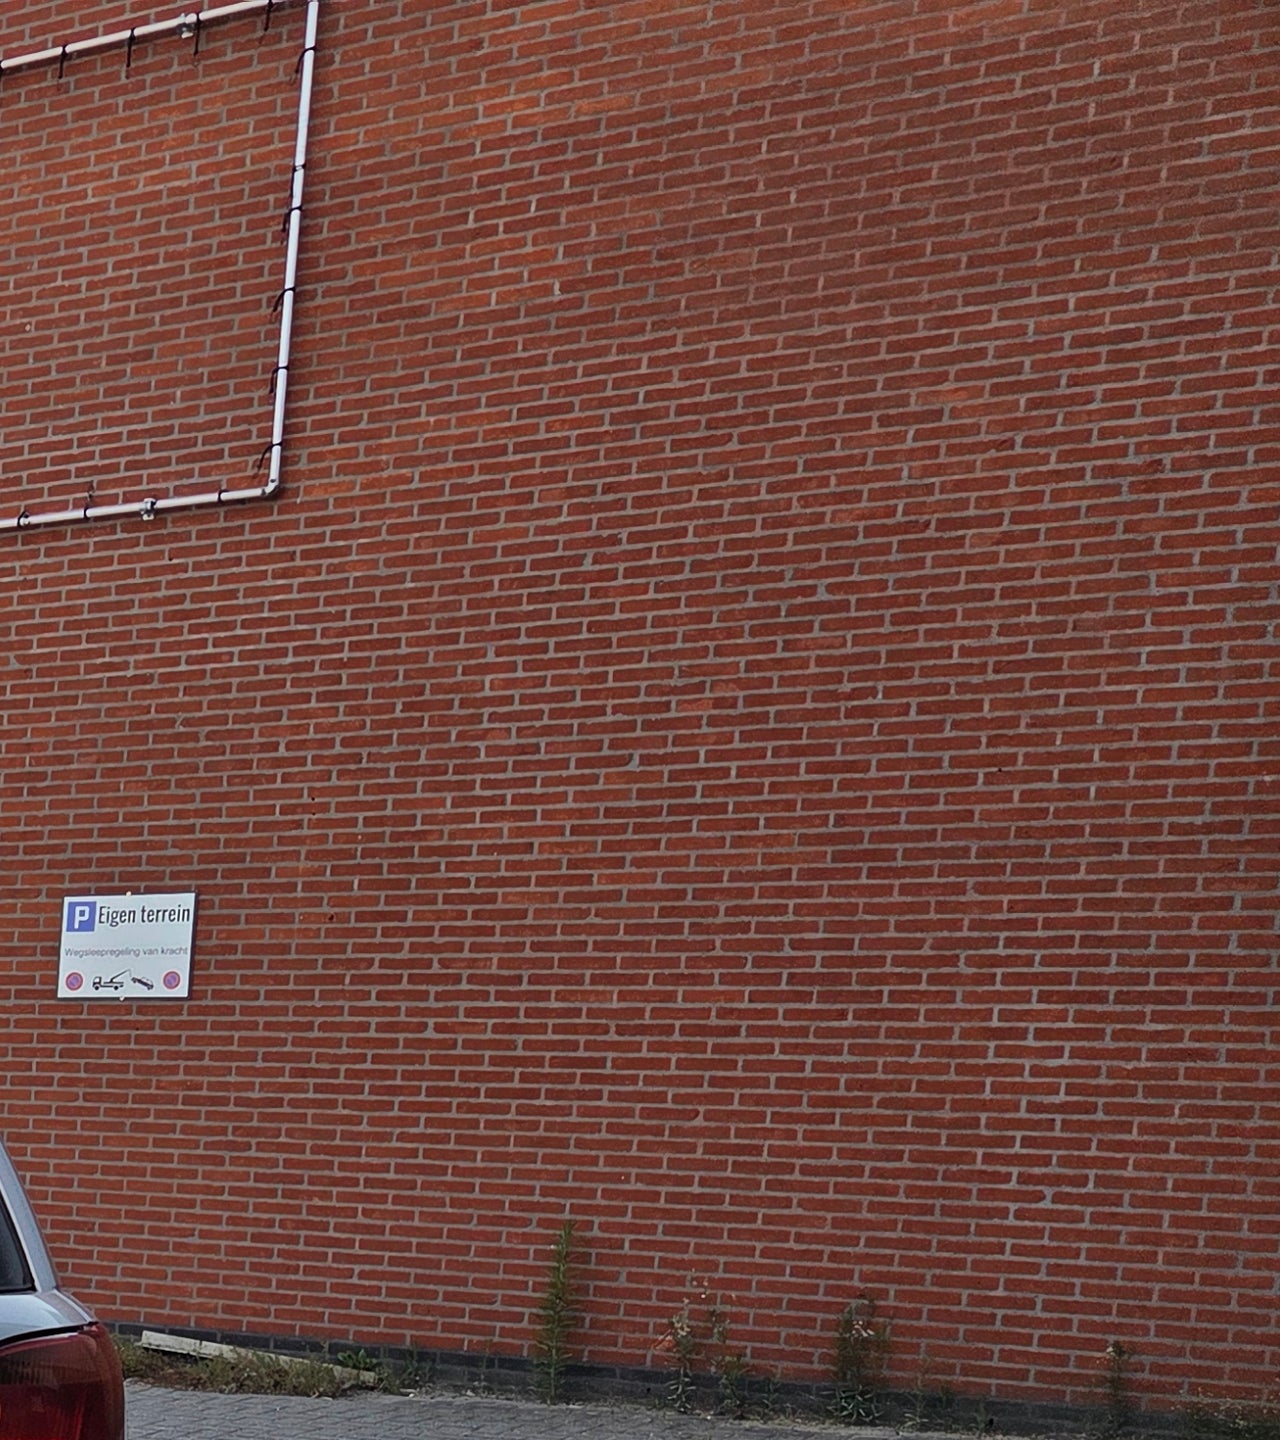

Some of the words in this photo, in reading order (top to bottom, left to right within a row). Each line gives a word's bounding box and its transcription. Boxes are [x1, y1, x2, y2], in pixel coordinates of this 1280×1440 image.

[98, 905, 136, 927] Eigen
[141, 904, 190, 923] terrein
[143, 947, 159, 955] van
[160, 946, 188, 955] kracht
